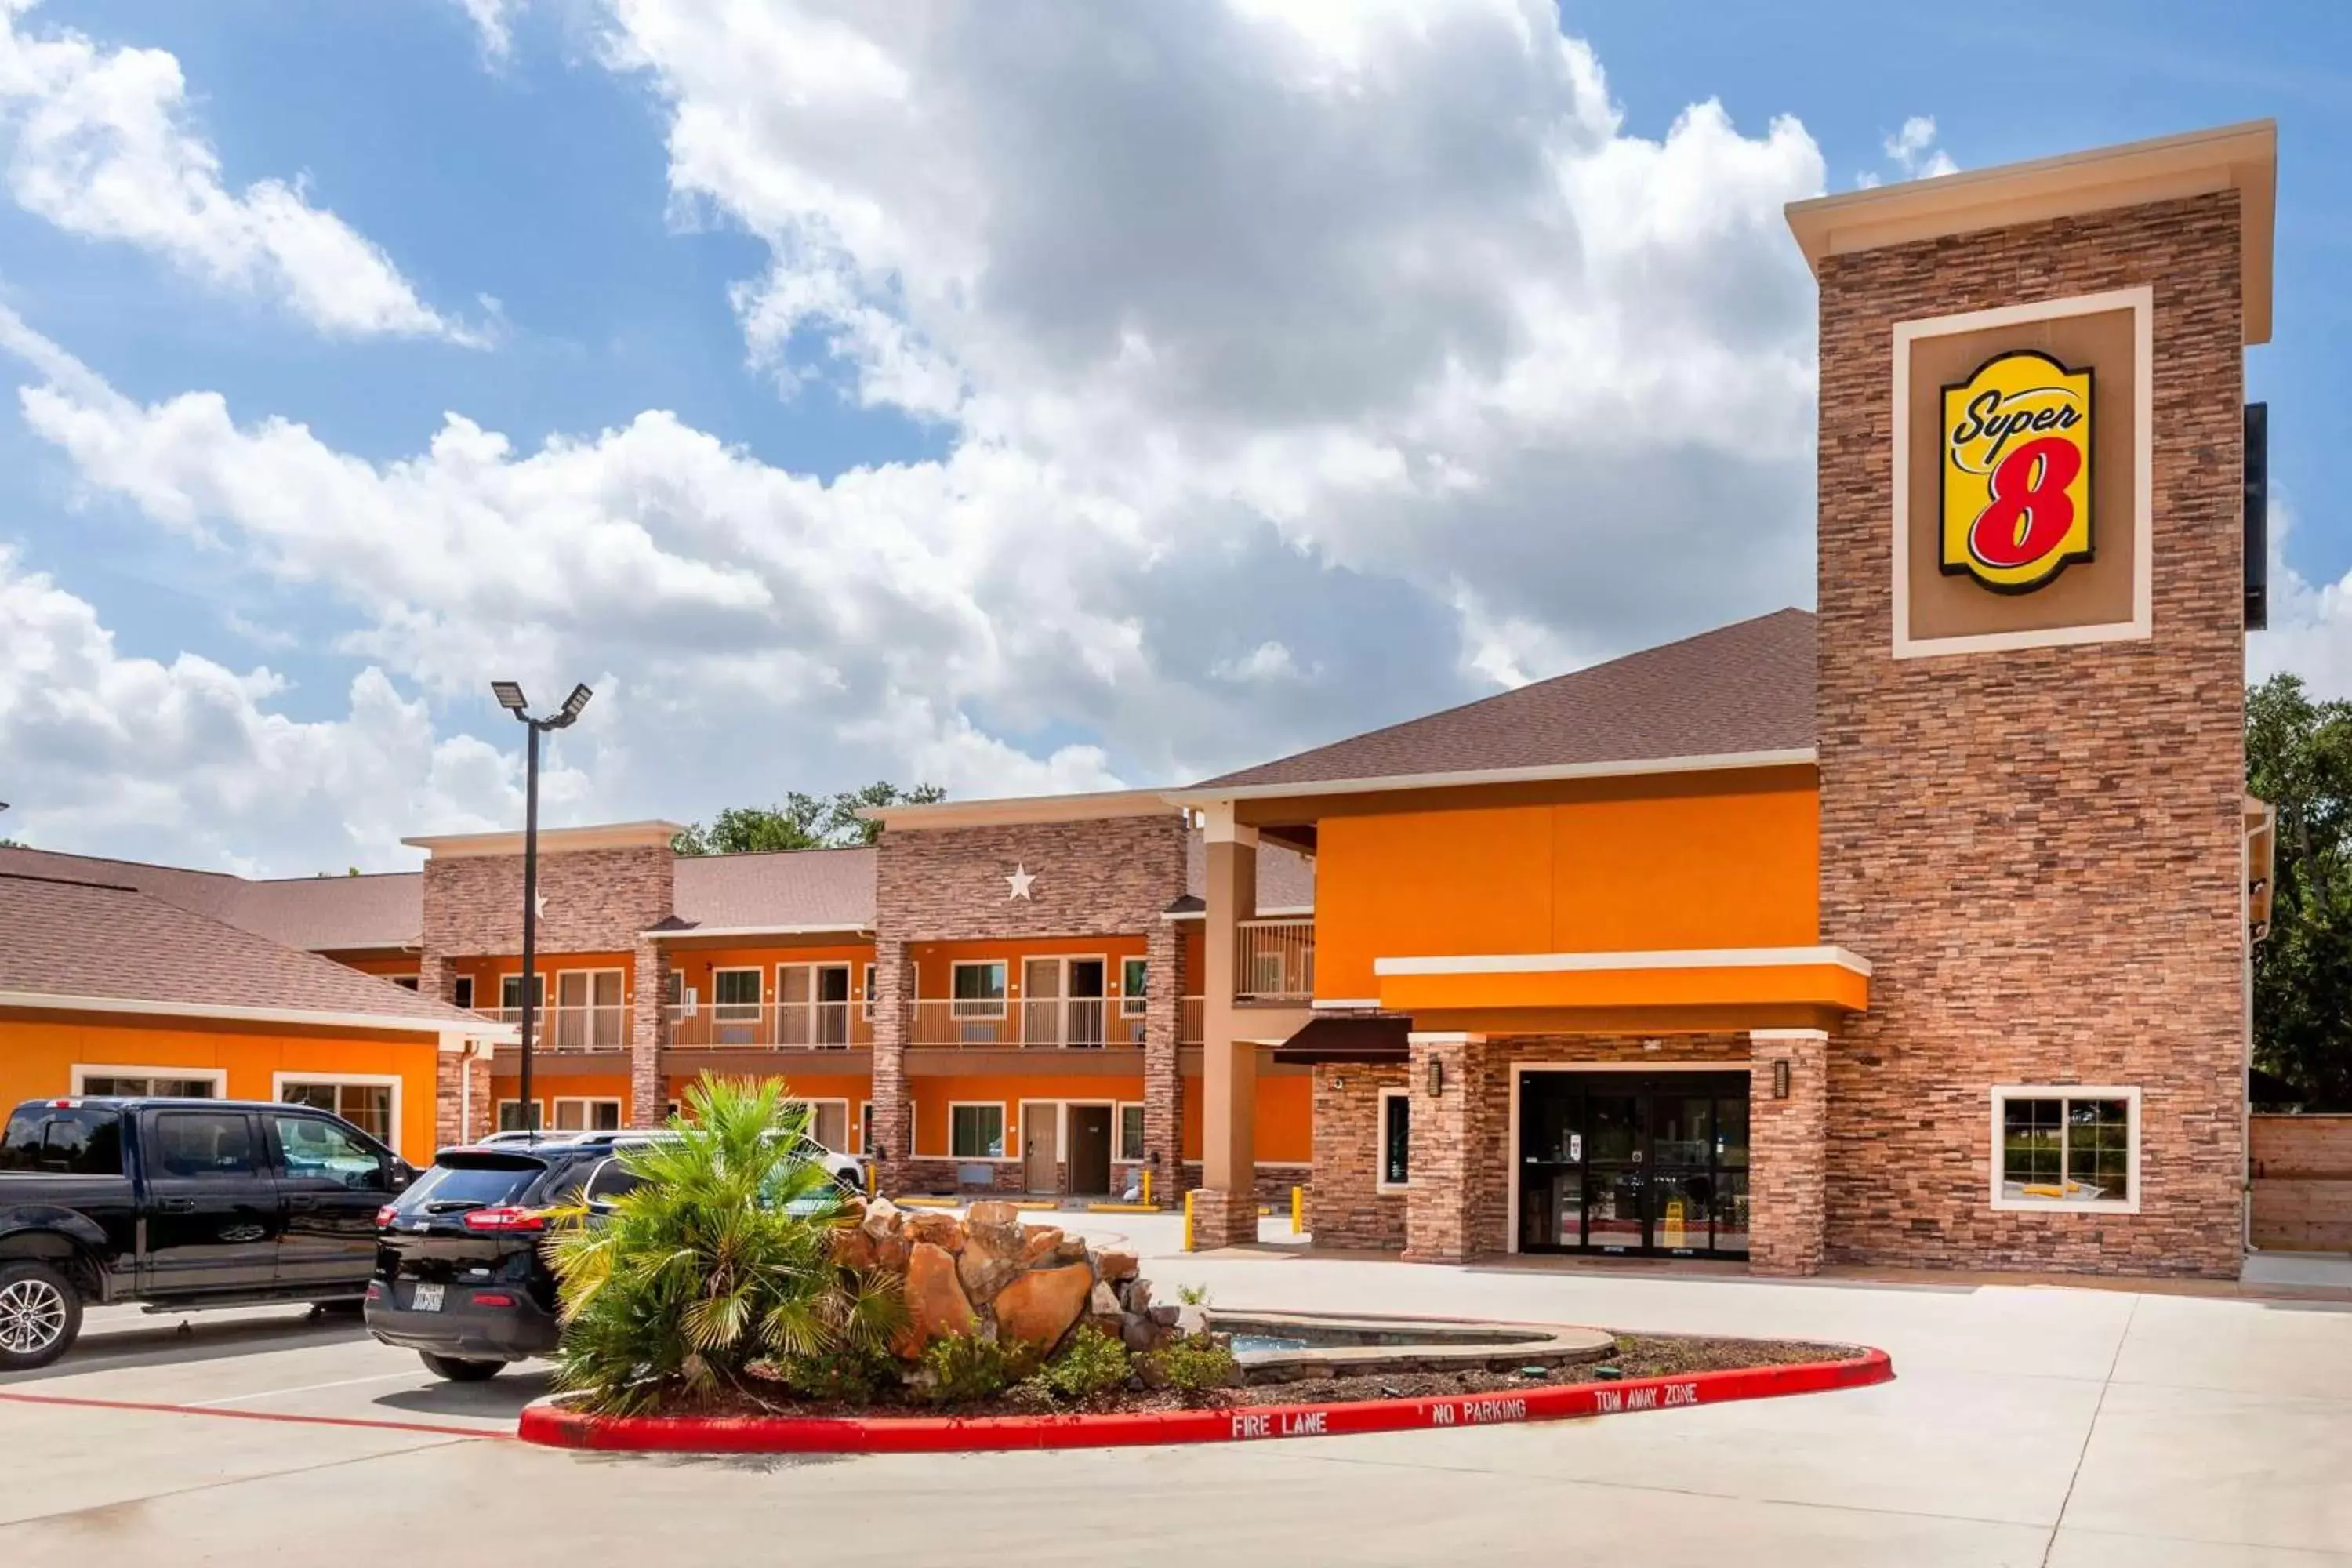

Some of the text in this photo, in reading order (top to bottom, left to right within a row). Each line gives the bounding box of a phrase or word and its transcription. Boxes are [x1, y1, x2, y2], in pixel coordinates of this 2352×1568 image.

[1952, 389, 2083, 465] Super
[1967, 436, 2082, 569] 8
[1432, 1398, 1526, 1424] NO PARKING
[1595, 1383, 1697, 1411] TOW AWAY ZONE
[1232, 1412, 1327, 1438] FIRE LANE
